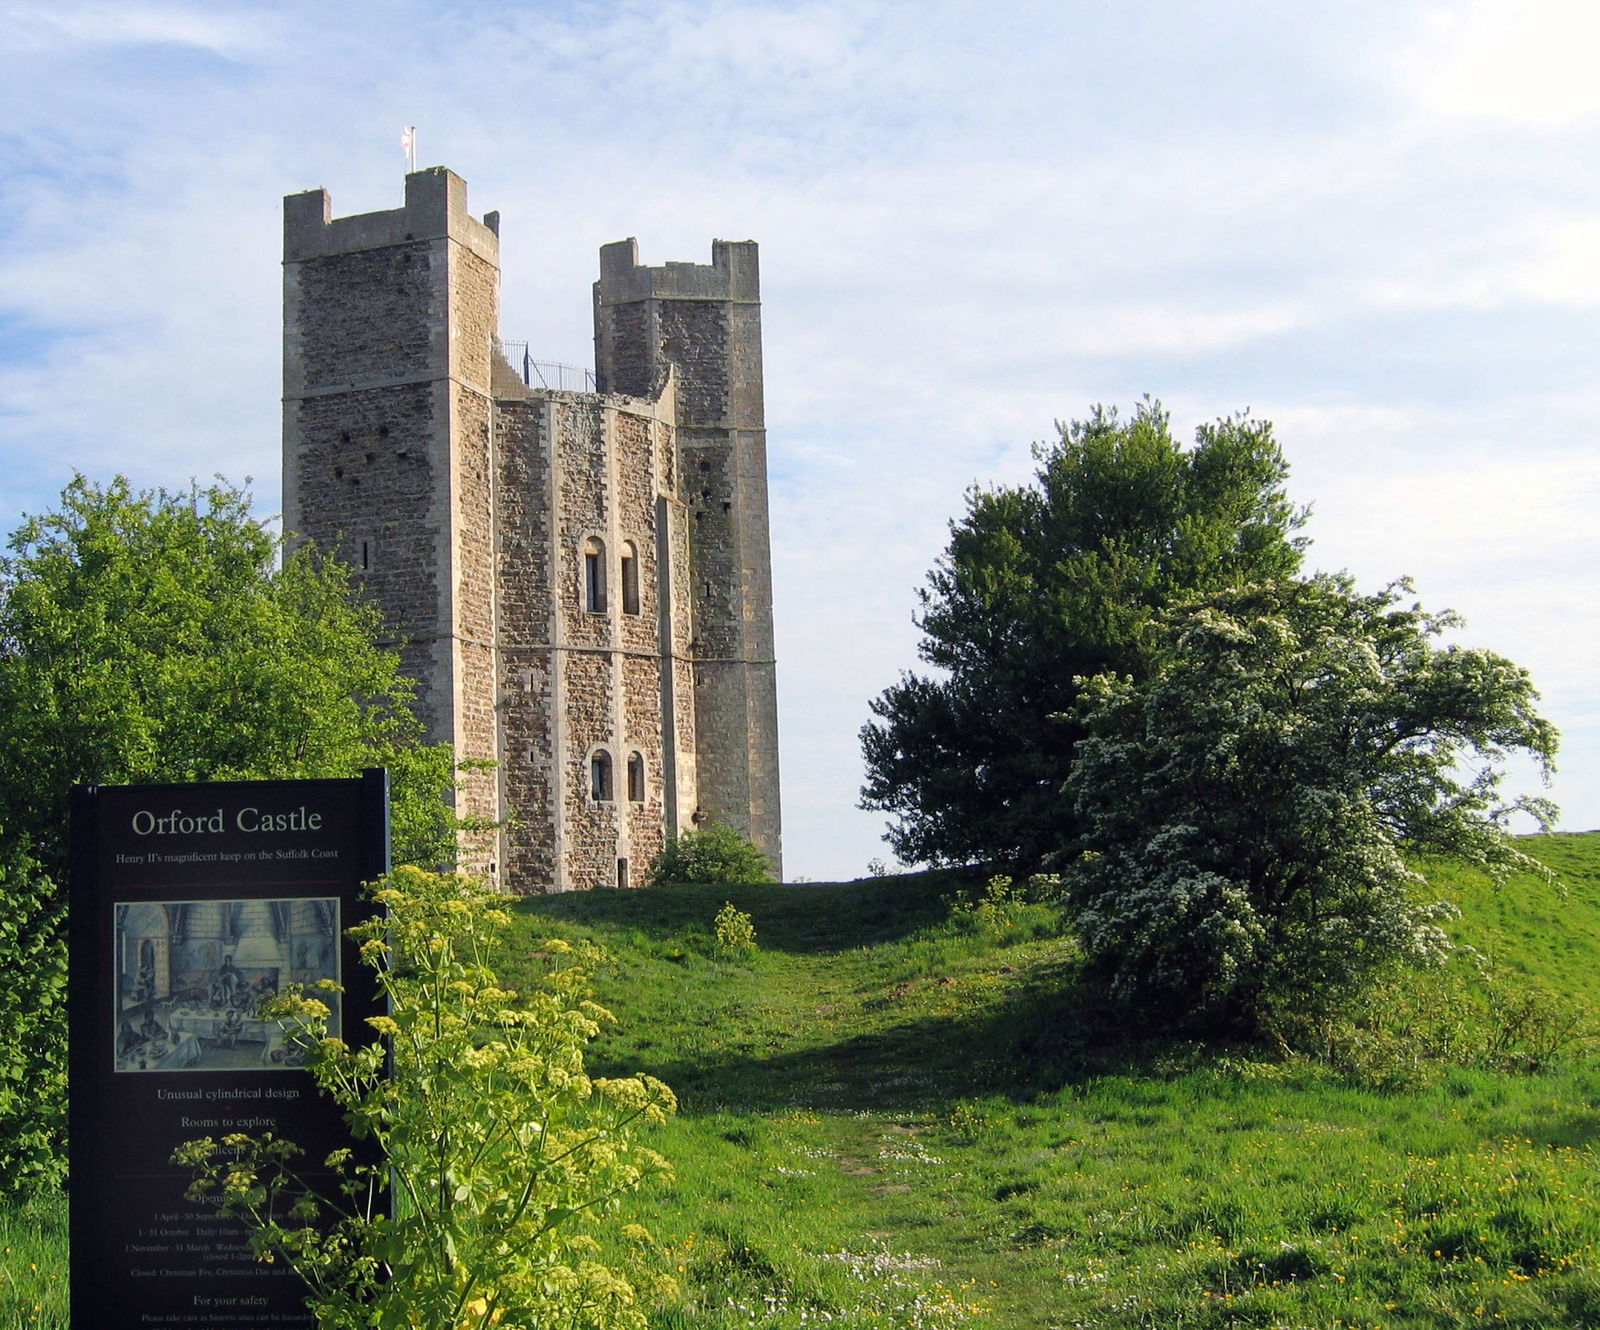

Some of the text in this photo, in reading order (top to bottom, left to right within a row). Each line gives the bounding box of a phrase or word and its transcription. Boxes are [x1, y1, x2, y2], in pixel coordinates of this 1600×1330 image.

[132, 807, 322, 835] Orford Castle
[116, 853, 144, 864] Henry
[164, 852, 217, 864] magnificent
[220, 851, 241, 862] keep
[243, 852, 256, 860] on
[258, 850, 273, 860] the
[276, 849, 309, 859] Suffolk
[311, 848, 338, 858] Coast
[157, 1088, 300, 1101] Unusual cylindrical design
[181, 1116, 276, 1128] Rooms to explore
[160, 1228, 190, 1236] October
[193, 1295, 269, 1308] For your safety
